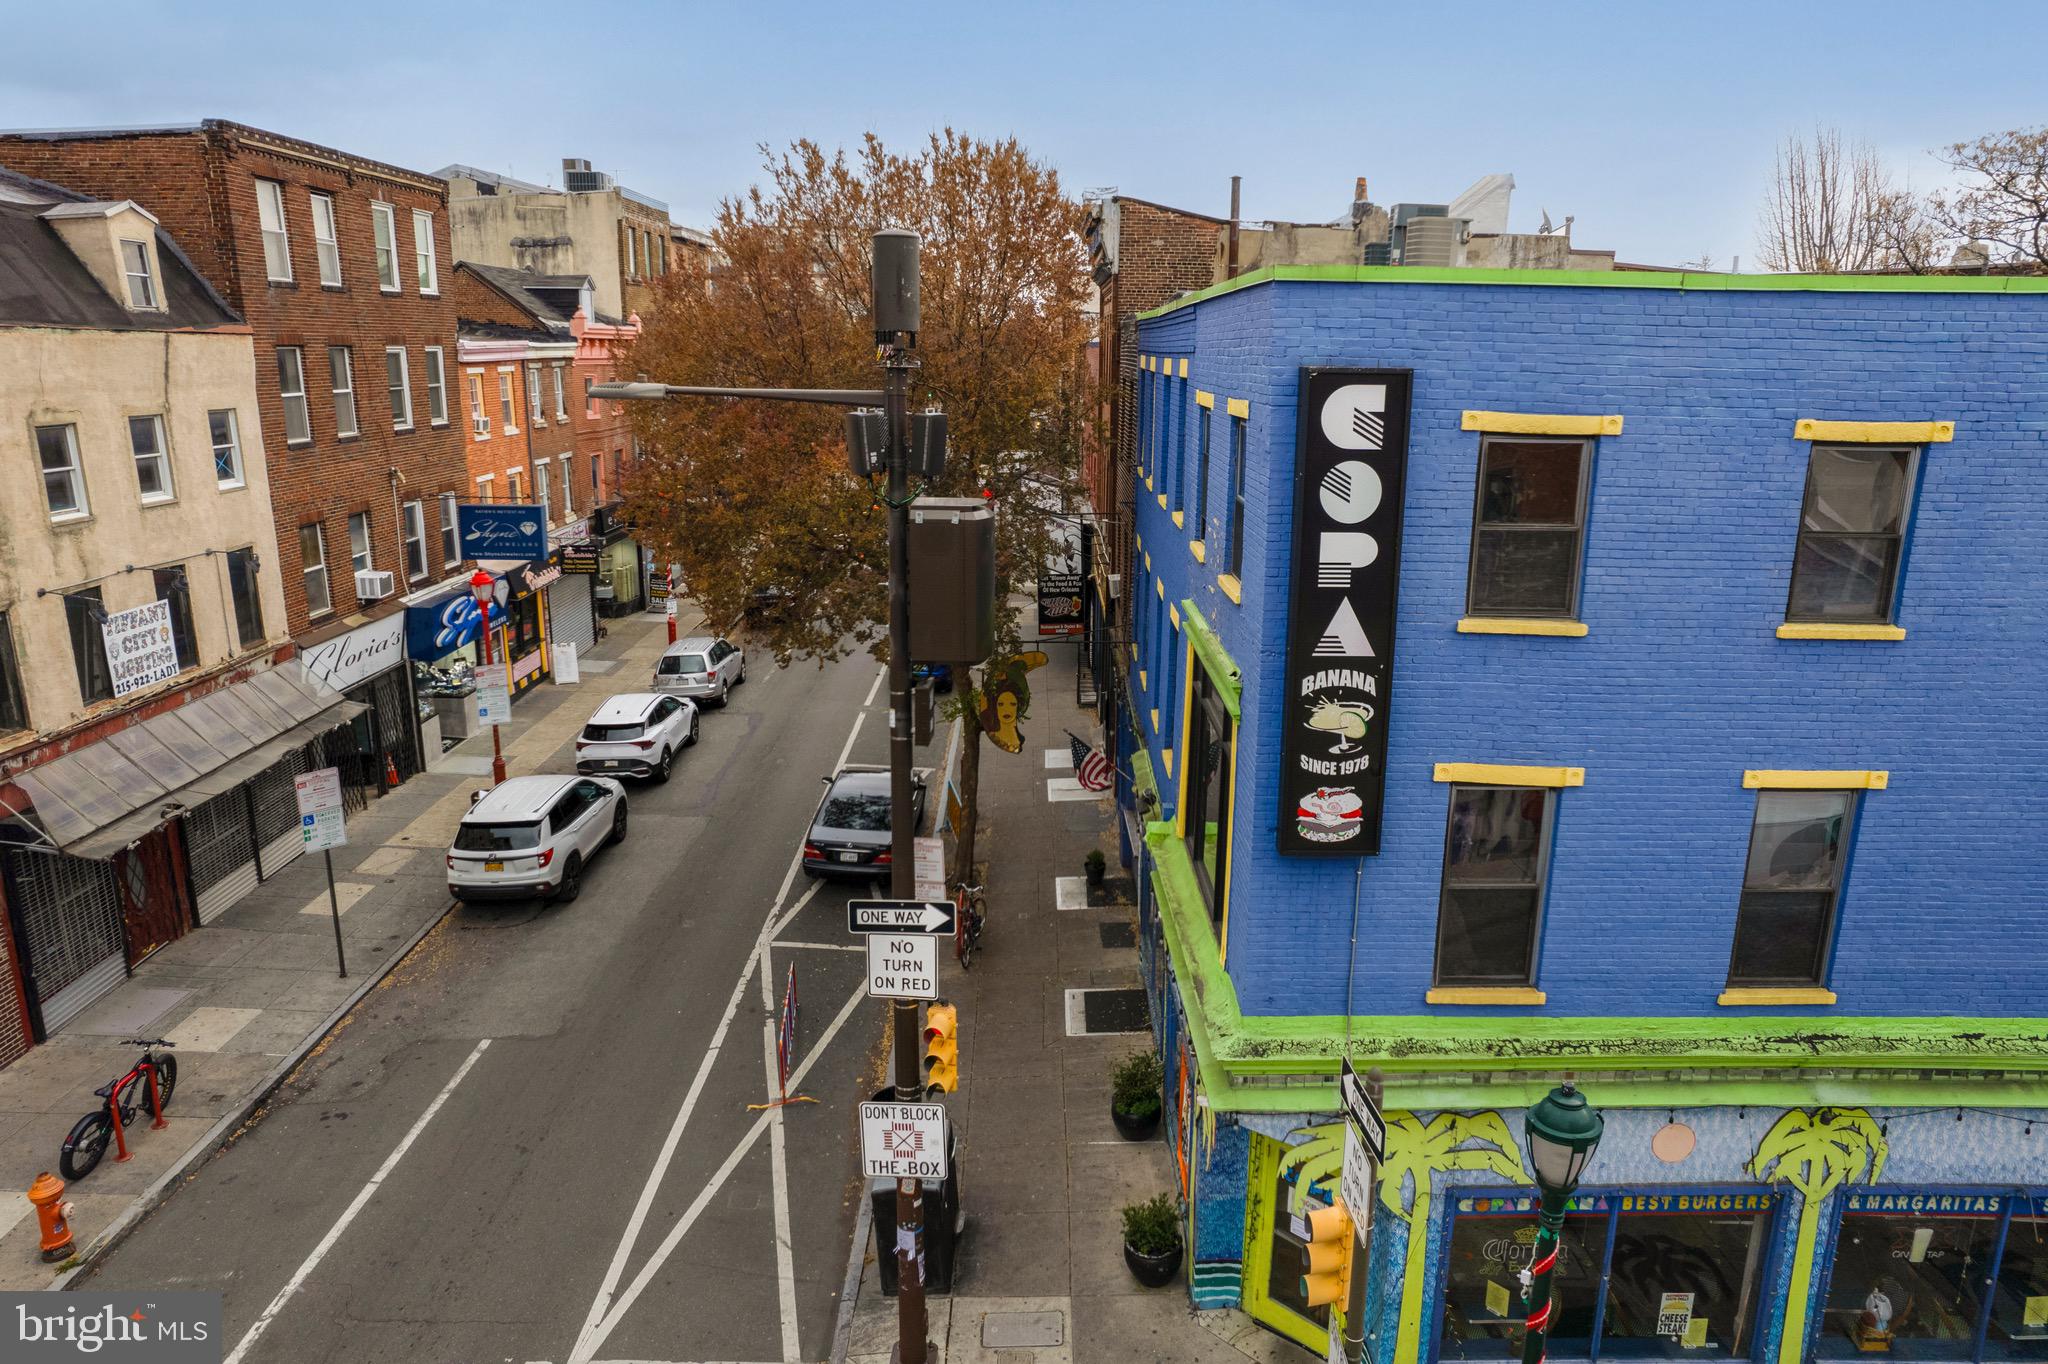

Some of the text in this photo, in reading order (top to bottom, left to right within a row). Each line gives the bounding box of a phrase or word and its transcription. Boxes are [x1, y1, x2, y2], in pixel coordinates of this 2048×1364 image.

[1311, 384, 1387, 657] COPA
[122, 627, 157, 654] CITY
[307, 631, 401, 689] Gloria's
[1301, 669, 1377, 697] BANANA
[1300, 754, 1370, 776] SINCE 1978
[861, 910, 923, 924] ONE WAY
[891, 941, 914, 954] NO
[883, 959, 923, 972] TURN
[875, 976, 931, 990] ON RED
[865, 1106, 940, 1121] DON'T BLOCK
[1352, 1088, 1380, 1142] ONE WAY
[1352, 1144, 1363, 1172] NO
[869, 1160, 940, 1176] THE BOX
[1348, 1160, 1365, 1202] TURN
[1344, 1177, 1365, 1230] ON RED
[1622, 1196, 1672, 1210] BEST
[1678, 1195, 1770, 1210] BURGERS
[1848, 1195, 1999, 1212] & MARGARITAS
[1659, 1313, 1688, 1324] CHEESE
[1658, 1324, 1687, 1334] STEAK!
